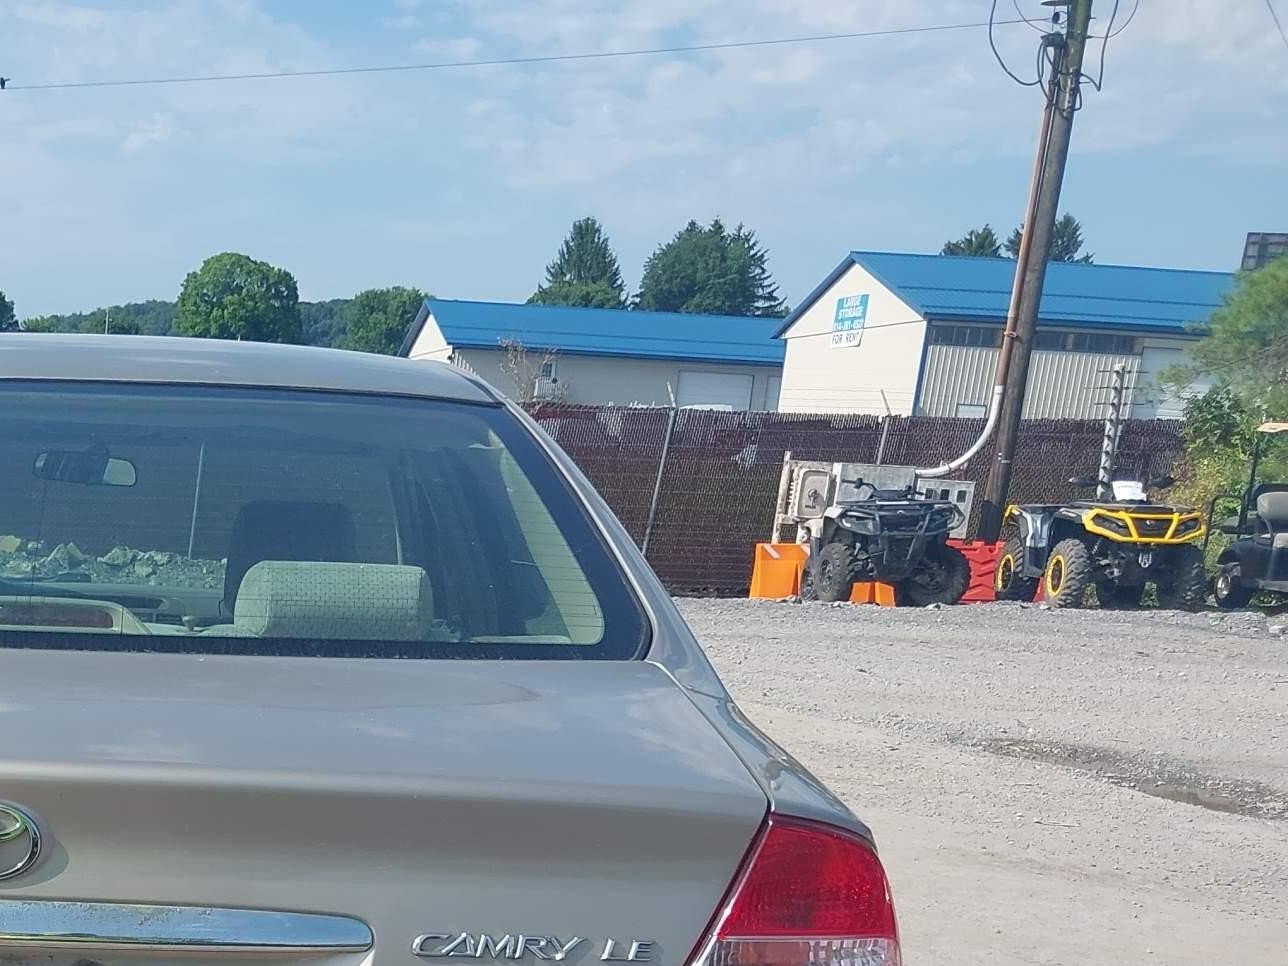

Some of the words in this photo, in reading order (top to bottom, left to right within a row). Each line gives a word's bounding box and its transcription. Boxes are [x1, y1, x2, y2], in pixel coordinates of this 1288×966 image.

[843, 296, 862, 308] LARGE
[838, 306, 864, 320] STORAGE
[832, 333, 843, 345] FOR
[845, 331, 860, 343] RENT
[412, 932, 585, 961] CAMRY
[600, 937, 654, 961] LE
